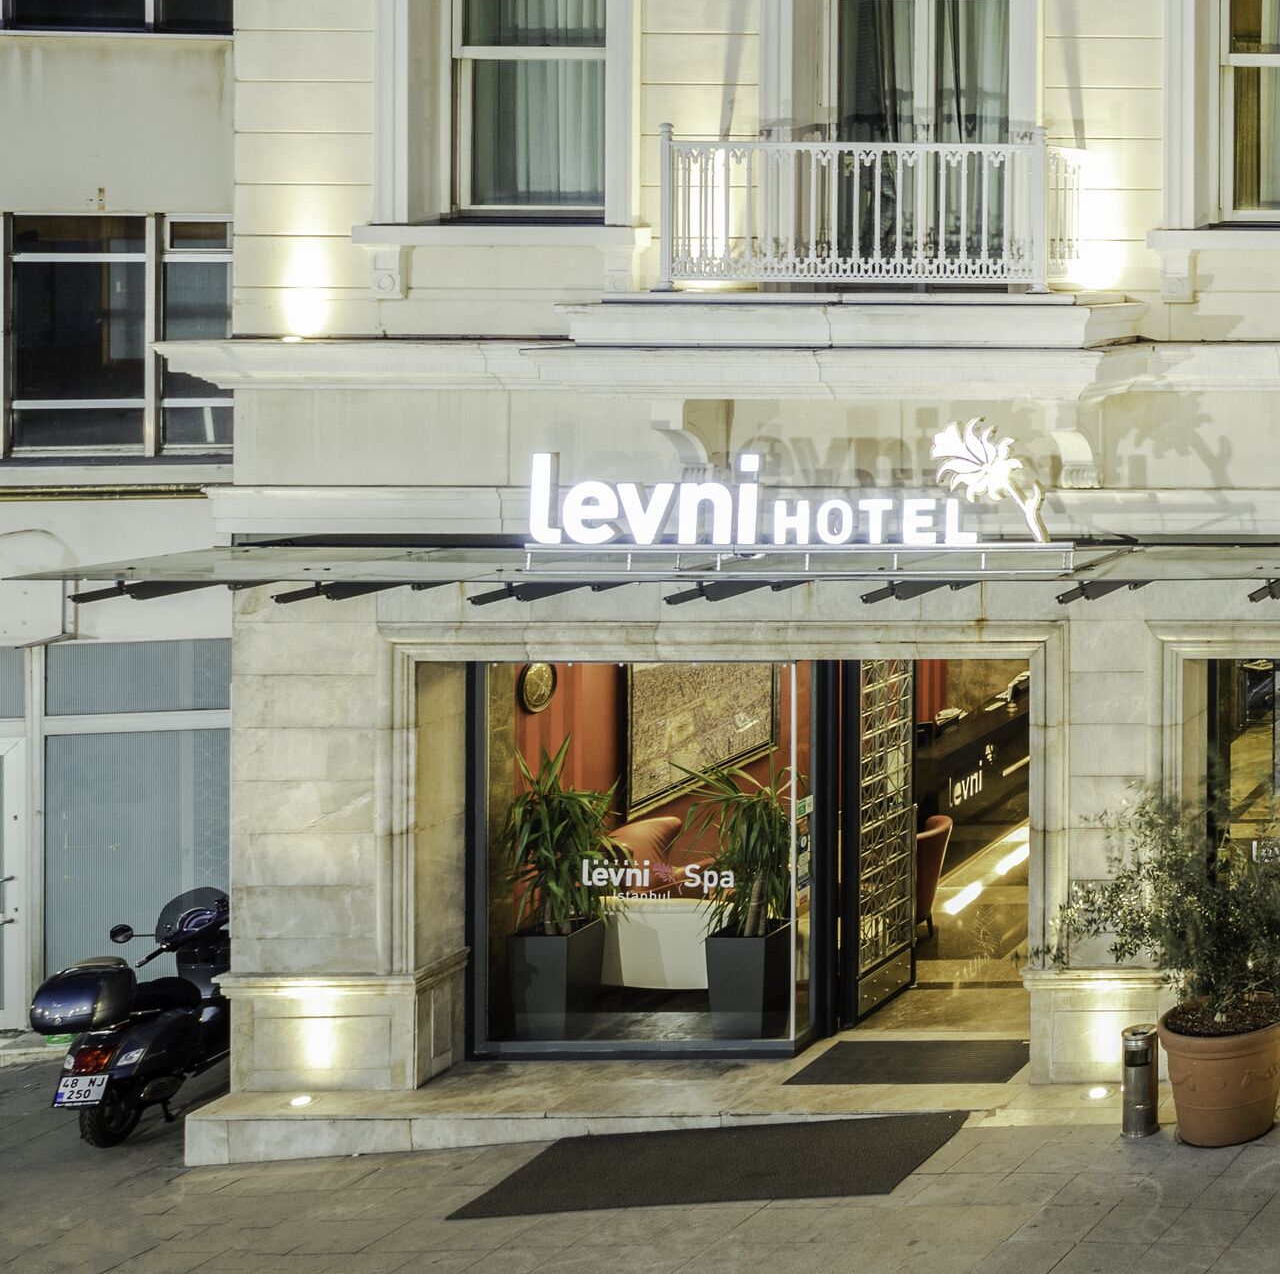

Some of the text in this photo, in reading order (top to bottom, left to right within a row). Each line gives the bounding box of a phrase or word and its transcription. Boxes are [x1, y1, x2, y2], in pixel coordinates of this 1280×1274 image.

[529, 452, 978, 545] levni HOTEL
[949, 760, 983, 808] levni
[582, 859, 735, 894] levni Spa
[63, 1077, 106, 1088] 48 NJ
[67, 1089, 91, 1099] 250
